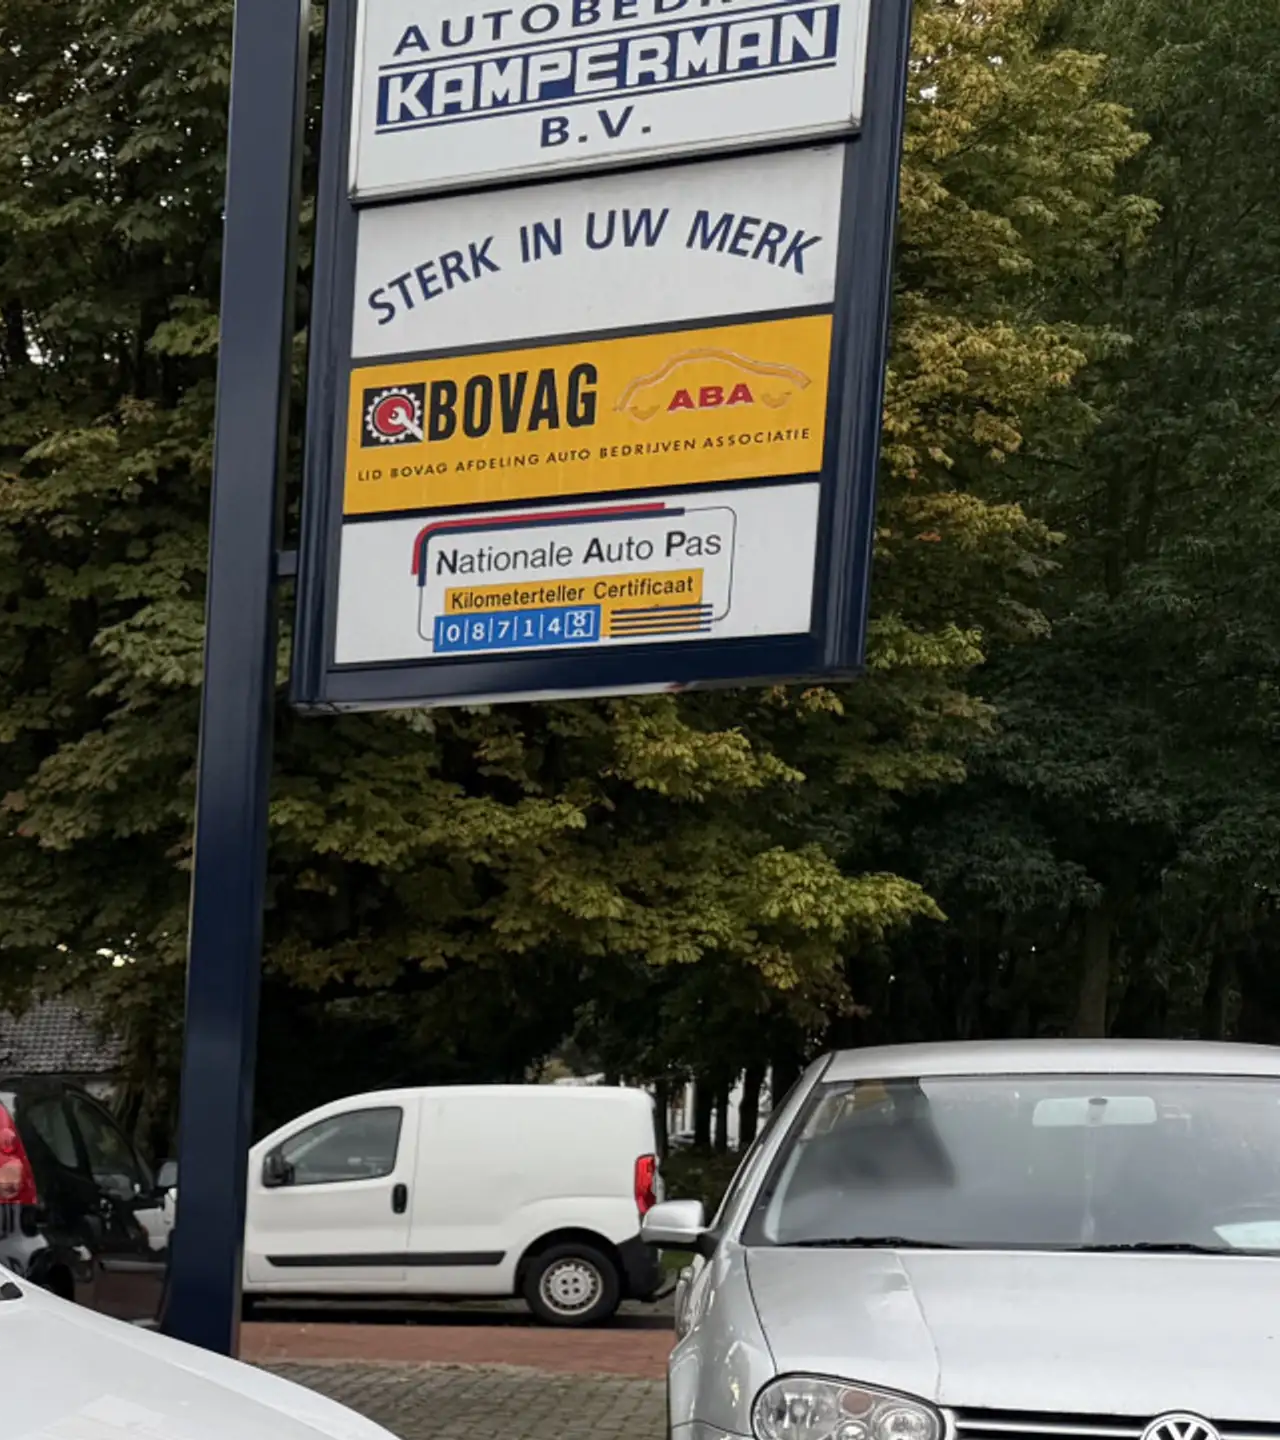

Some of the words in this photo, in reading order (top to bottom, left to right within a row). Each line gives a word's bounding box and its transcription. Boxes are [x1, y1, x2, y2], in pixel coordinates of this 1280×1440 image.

[393, 0, 731, 57] AUTOBE
[386, 7, 828, 123] KAMPERMAN
[540, 104, 652, 149] B.V.
[368, 235, 501, 326] STERK
[520, 218, 563, 263] IN
[586, 208, 670, 250] UW
[686, 210, 823, 275] MERK
[428, 362, 598, 442] BOVAG
[666, 382, 755, 413] ABA
[357, 469, 383, 482] LID
[390, 463, 448, 479] BOVAG
[455, 454, 540, 473] AFDELING
[546, 449, 591, 463] AUTO
[600, 439, 697, 459] BEDRIJVEN
[703, 428, 811, 449] ASSOCIATIE
[436, 542, 573, 575] Nationale
[583, 537, 654, 564] Auto
[665, 530, 722, 557] Pas
[451, 585, 585, 610] Kilometerteller
[593, 576, 693, 599] Certificaat
